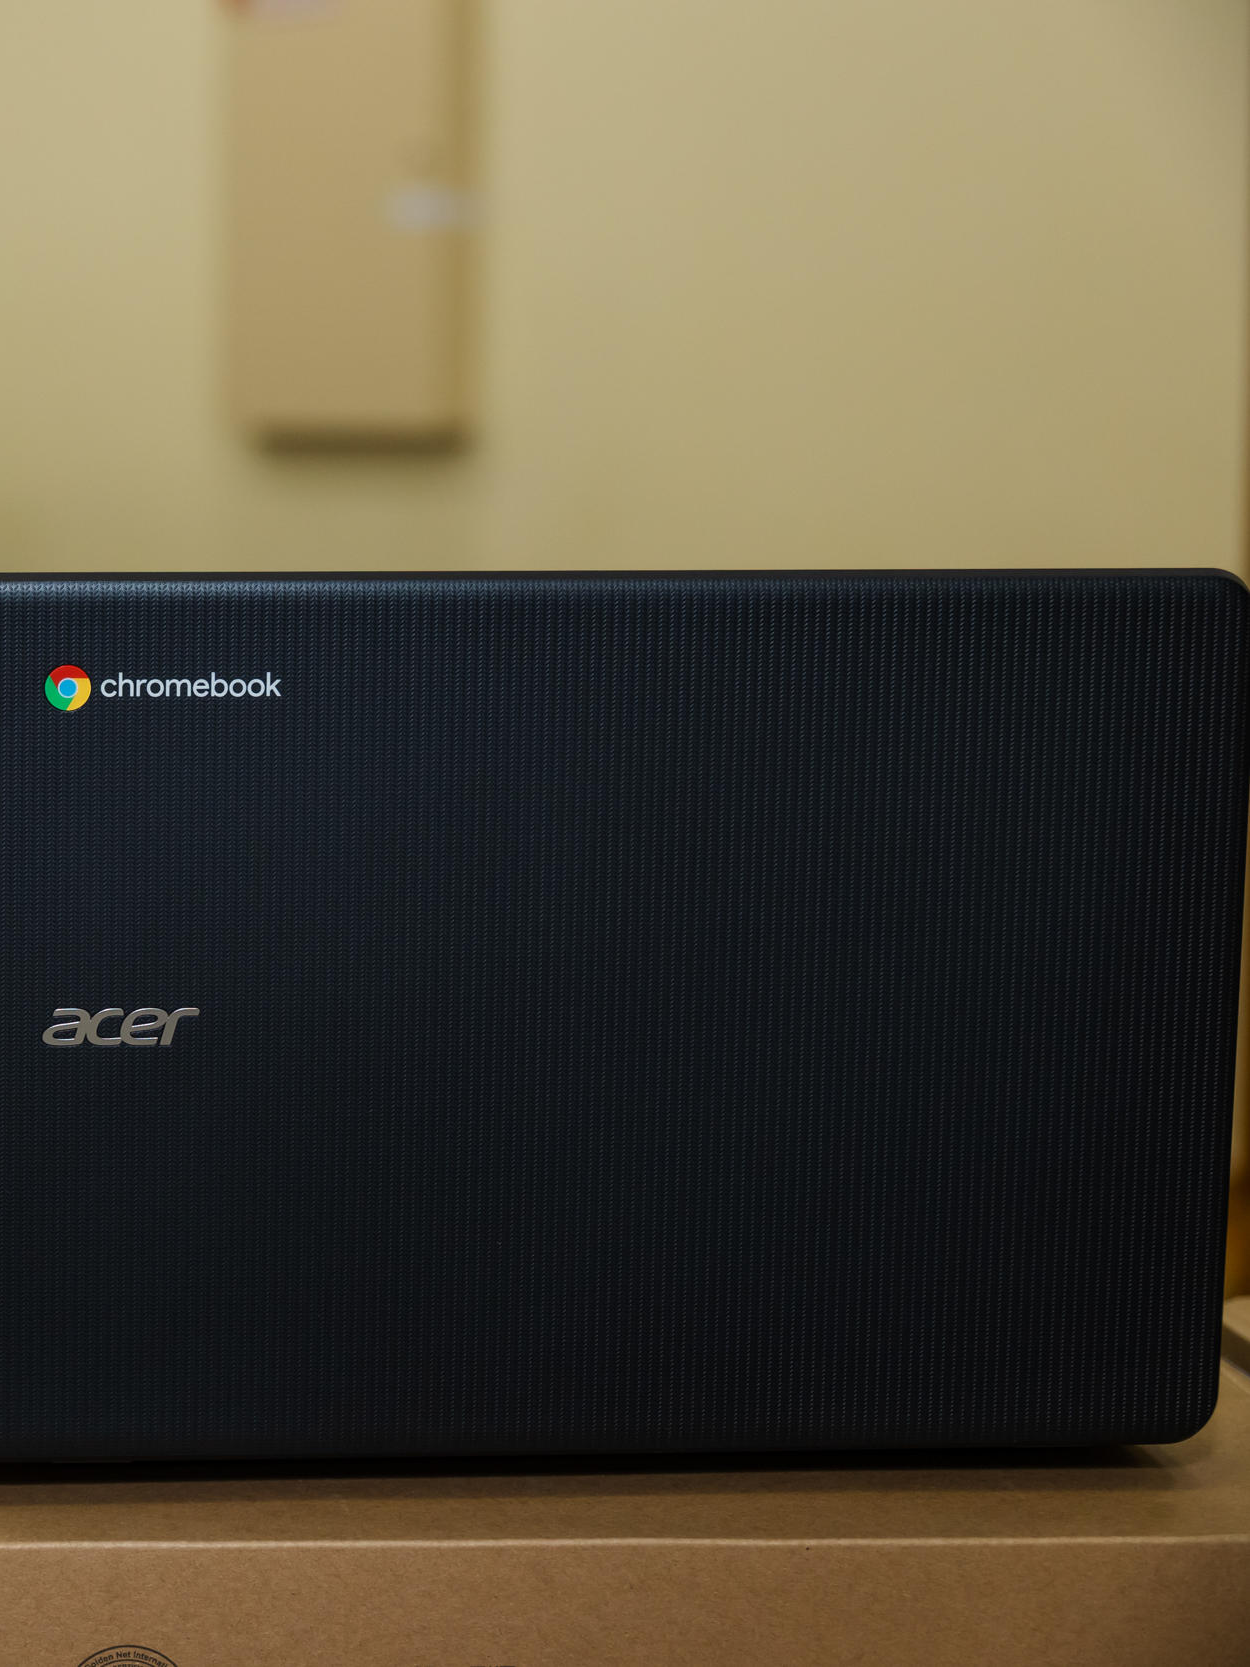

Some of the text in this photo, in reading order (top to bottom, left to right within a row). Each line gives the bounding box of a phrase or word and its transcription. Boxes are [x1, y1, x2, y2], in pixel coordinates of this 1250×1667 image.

[100, 672, 282, 698] chromebook
[42, 1007, 200, 1046] acer
[116, 1651, 131, 1659] Net
